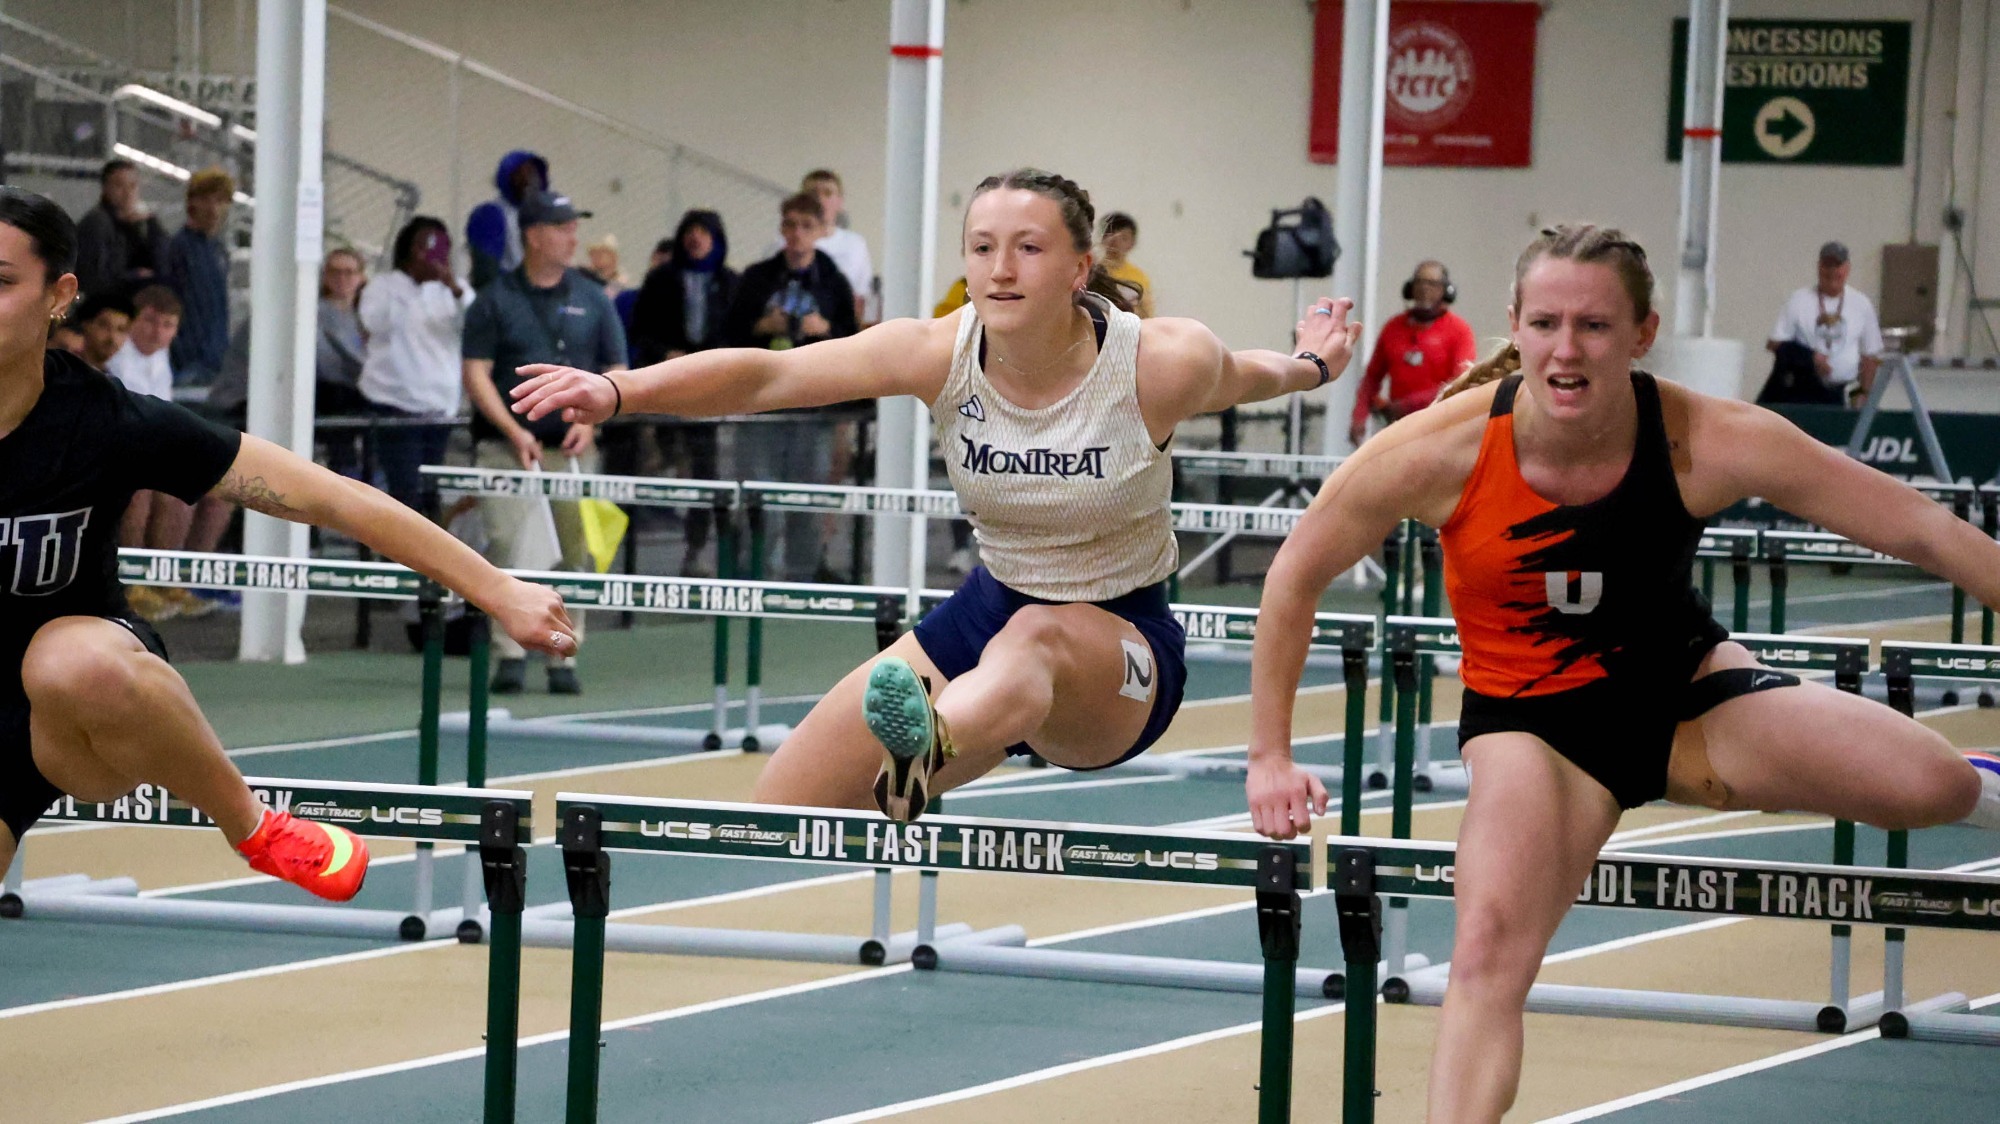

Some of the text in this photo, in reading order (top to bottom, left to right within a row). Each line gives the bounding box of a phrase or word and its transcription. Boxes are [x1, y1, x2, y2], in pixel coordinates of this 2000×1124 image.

[1727, 28, 1883, 54] NCESSIONS
[1860, 437, 1918, 463] JDL
[145, 556, 181, 583] JDL
[190, 560, 237, 586] FAST
[245, 562, 309, 589] TRACK
[598, 581, 635, 606] JDL
[643, 583, 691, 609] FAST
[699, 586, 764, 612] TRACK
[1546, 571, 1603, 614] U
[1762, 648, 1810, 661] UCS
[1937, 656, 1987, 670] UCS
[1126, 651, 1152, 687] 2
[300, 806, 363, 818] FAST TRACK
[371, 806, 443, 826] UCS
[640, 819, 712, 840] UCS
[720, 829, 783, 841] FAST TRACK
[789, 818, 1065, 872] JDL FAST TRACK
[1071, 850, 1136, 862] FAST TRACK
[1145, 850, 1218, 871] UCS
[1415, 863, 1455, 882] UC
[1656, 867, 1738, 911] FAST
[1757, 873, 1873, 919] TRACK
